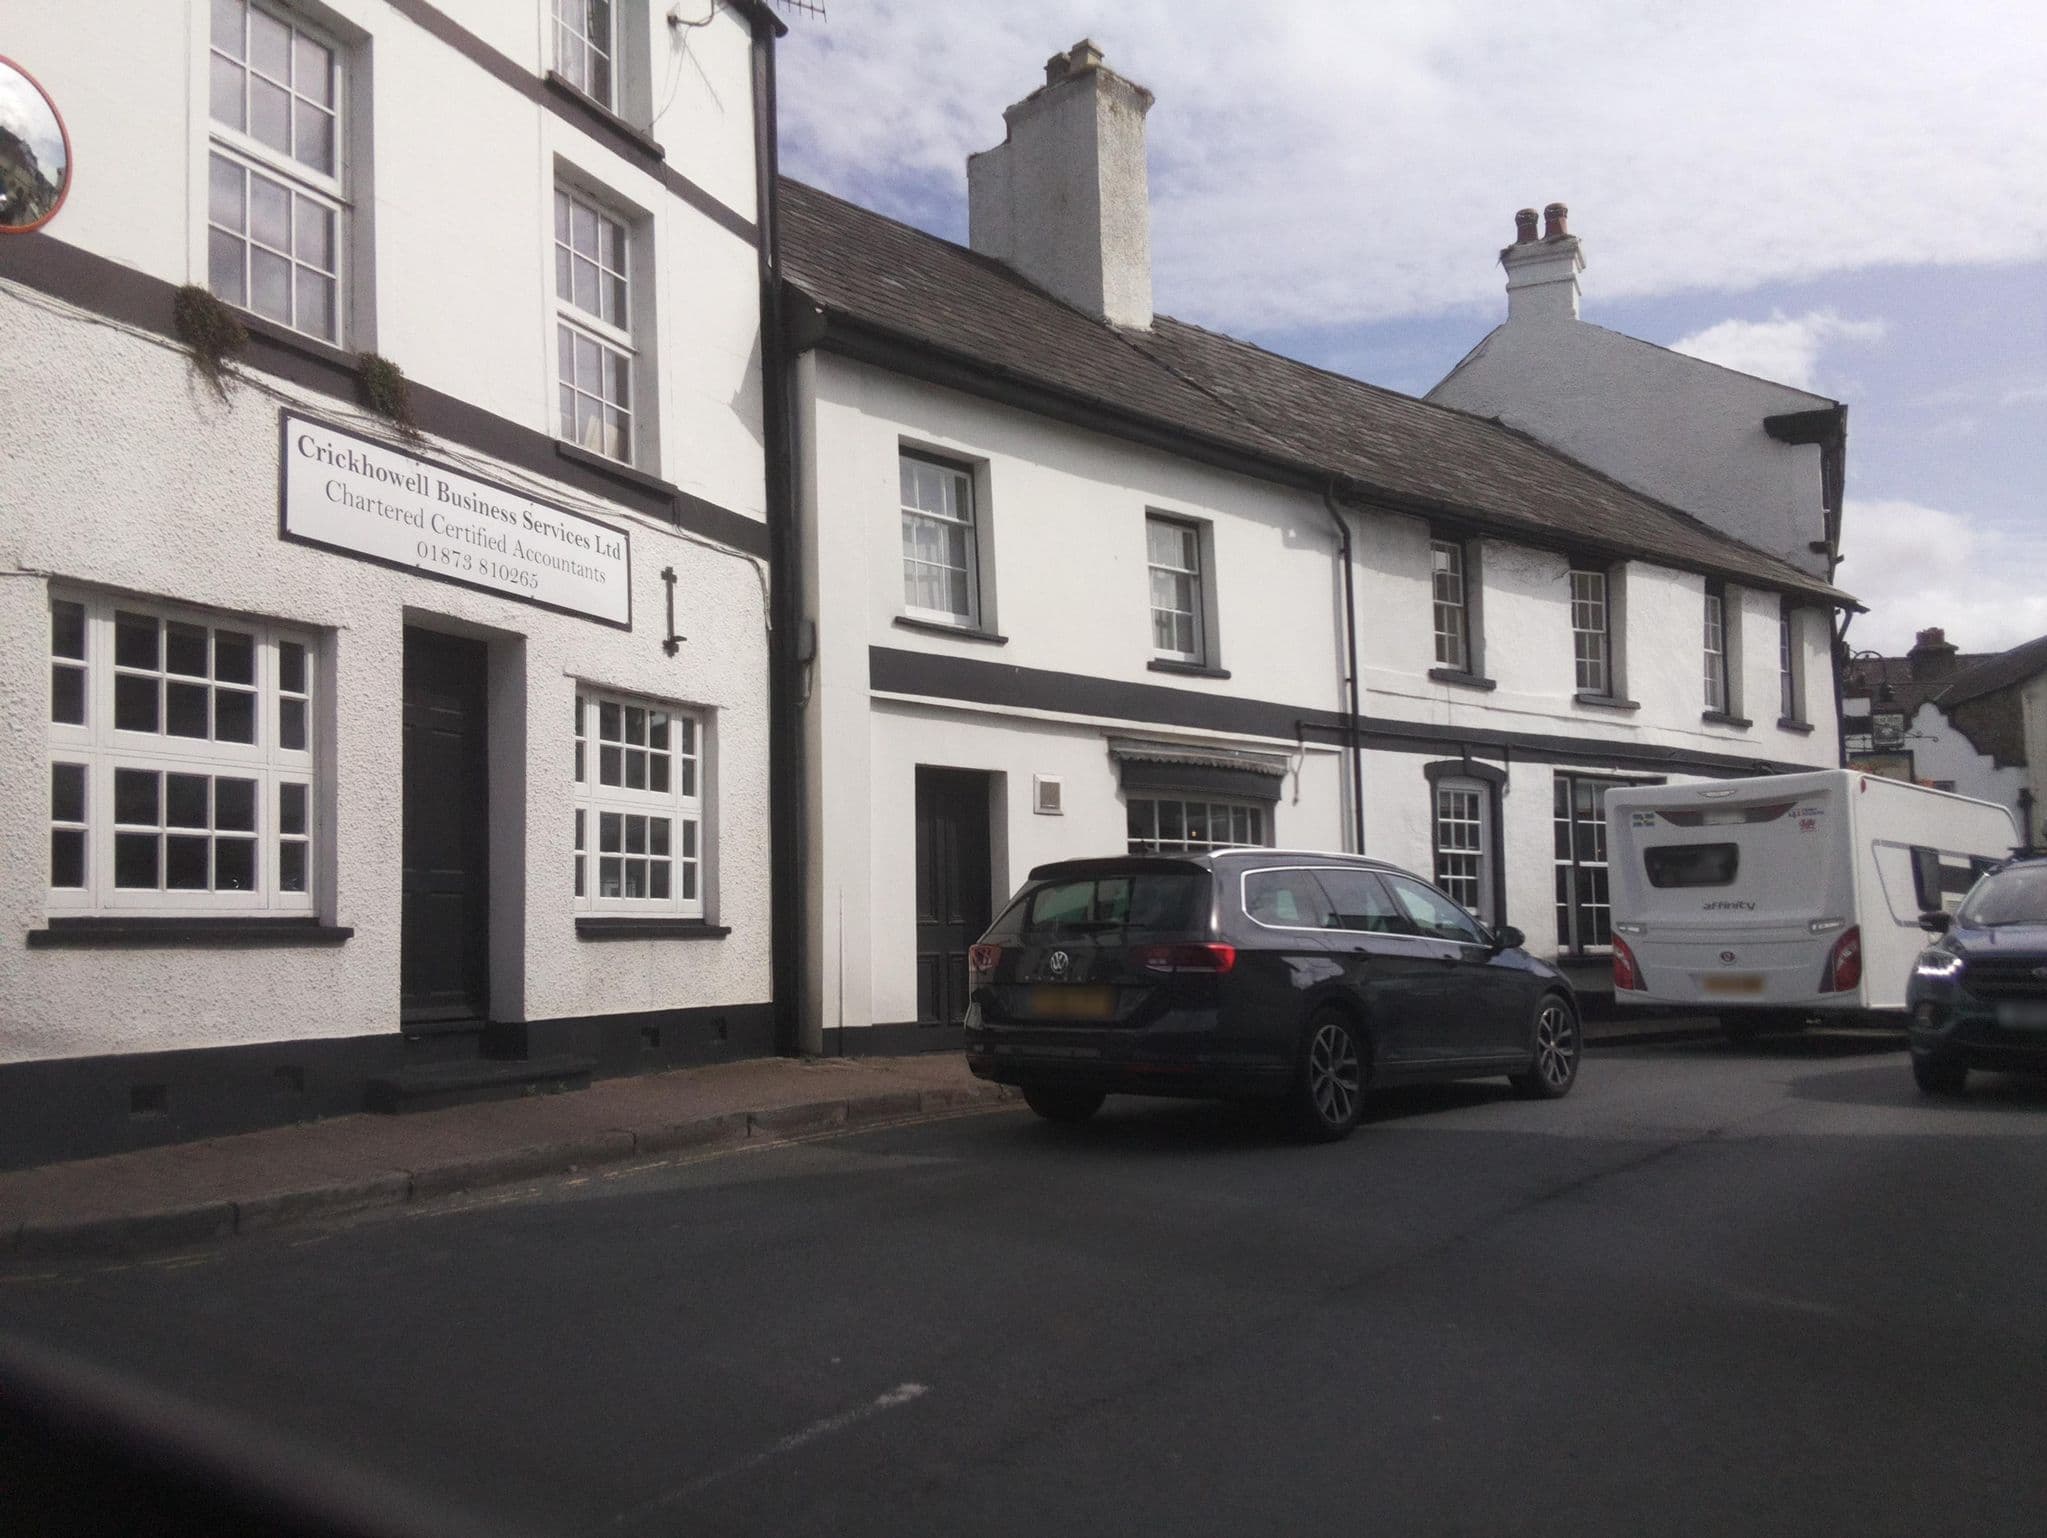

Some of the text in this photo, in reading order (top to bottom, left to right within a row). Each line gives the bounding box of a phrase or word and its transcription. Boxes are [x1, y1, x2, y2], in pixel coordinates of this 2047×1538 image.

[298, 434, 621, 560] Crickhowell Business Services Ltd
[326, 479, 606, 584] Chartered Certified Accountants
[417, 541, 539, 589] 01873 810265
[1703, 900, 1756, 911] affinity
